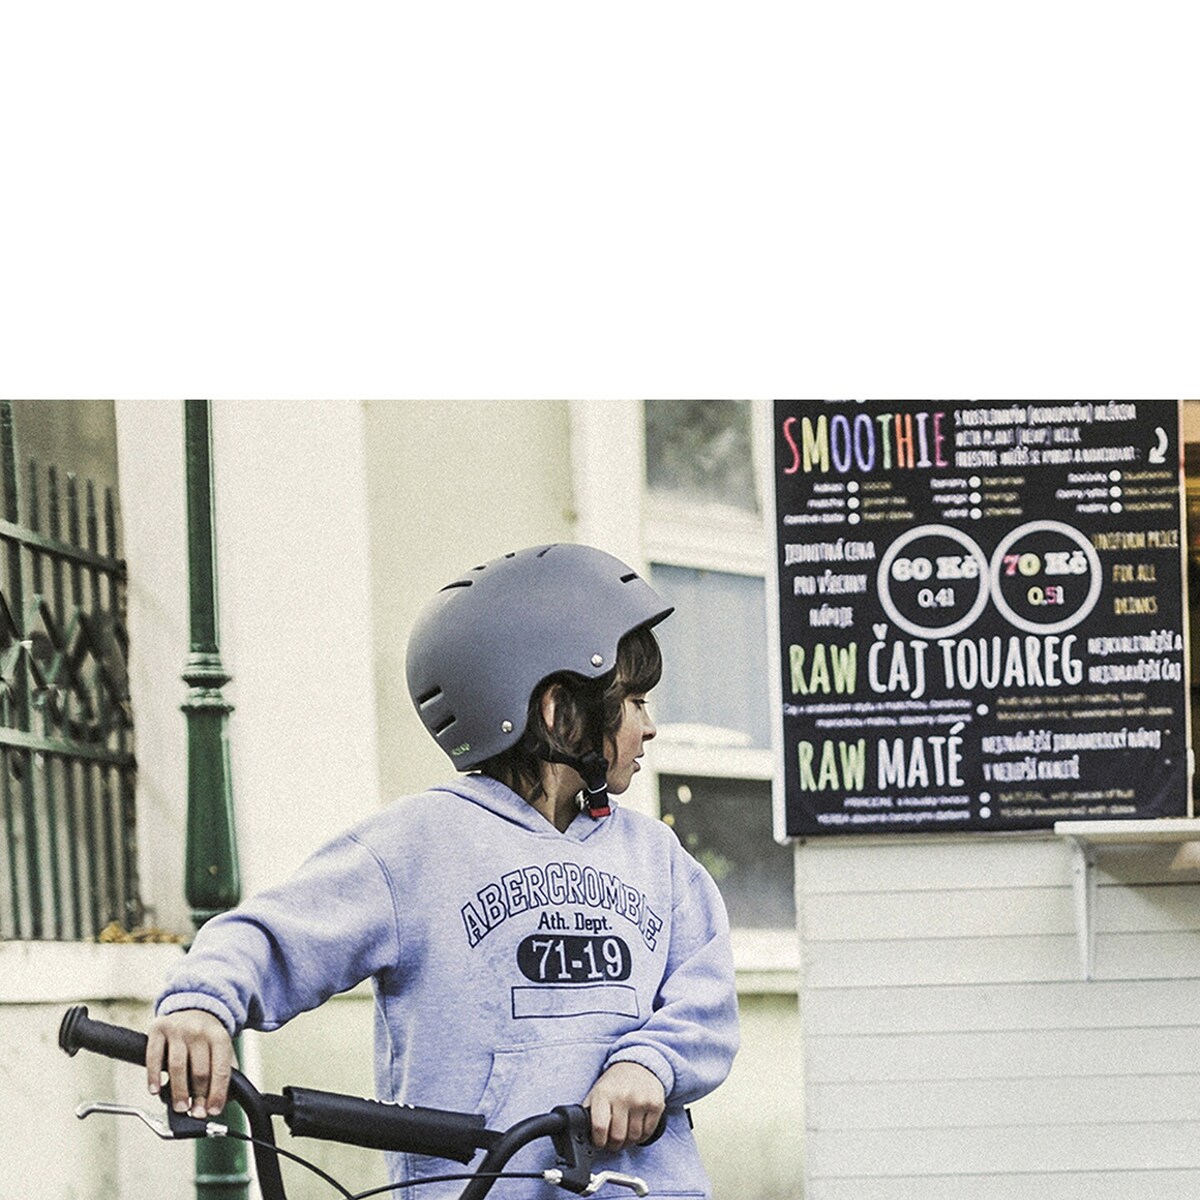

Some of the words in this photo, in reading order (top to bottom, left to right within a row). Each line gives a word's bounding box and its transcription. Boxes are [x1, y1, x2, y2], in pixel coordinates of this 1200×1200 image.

[783, 412, 948, 474] SMOOTHIE
[890, 554, 932, 581] 60
[1000, 550, 1040, 576] 70
[789, 642, 857, 695] RAW
[868, 622, 928, 698] ČAJ
[937, 633, 1082, 690] TOUAREG
[798, 738, 865, 792] RAW
[876, 721, 965, 790] MATÉ
[538, 911, 570, 930] Ath.
[574, 912, 613, 934] Dept.
[532, 938, 623, 980] 71-19
